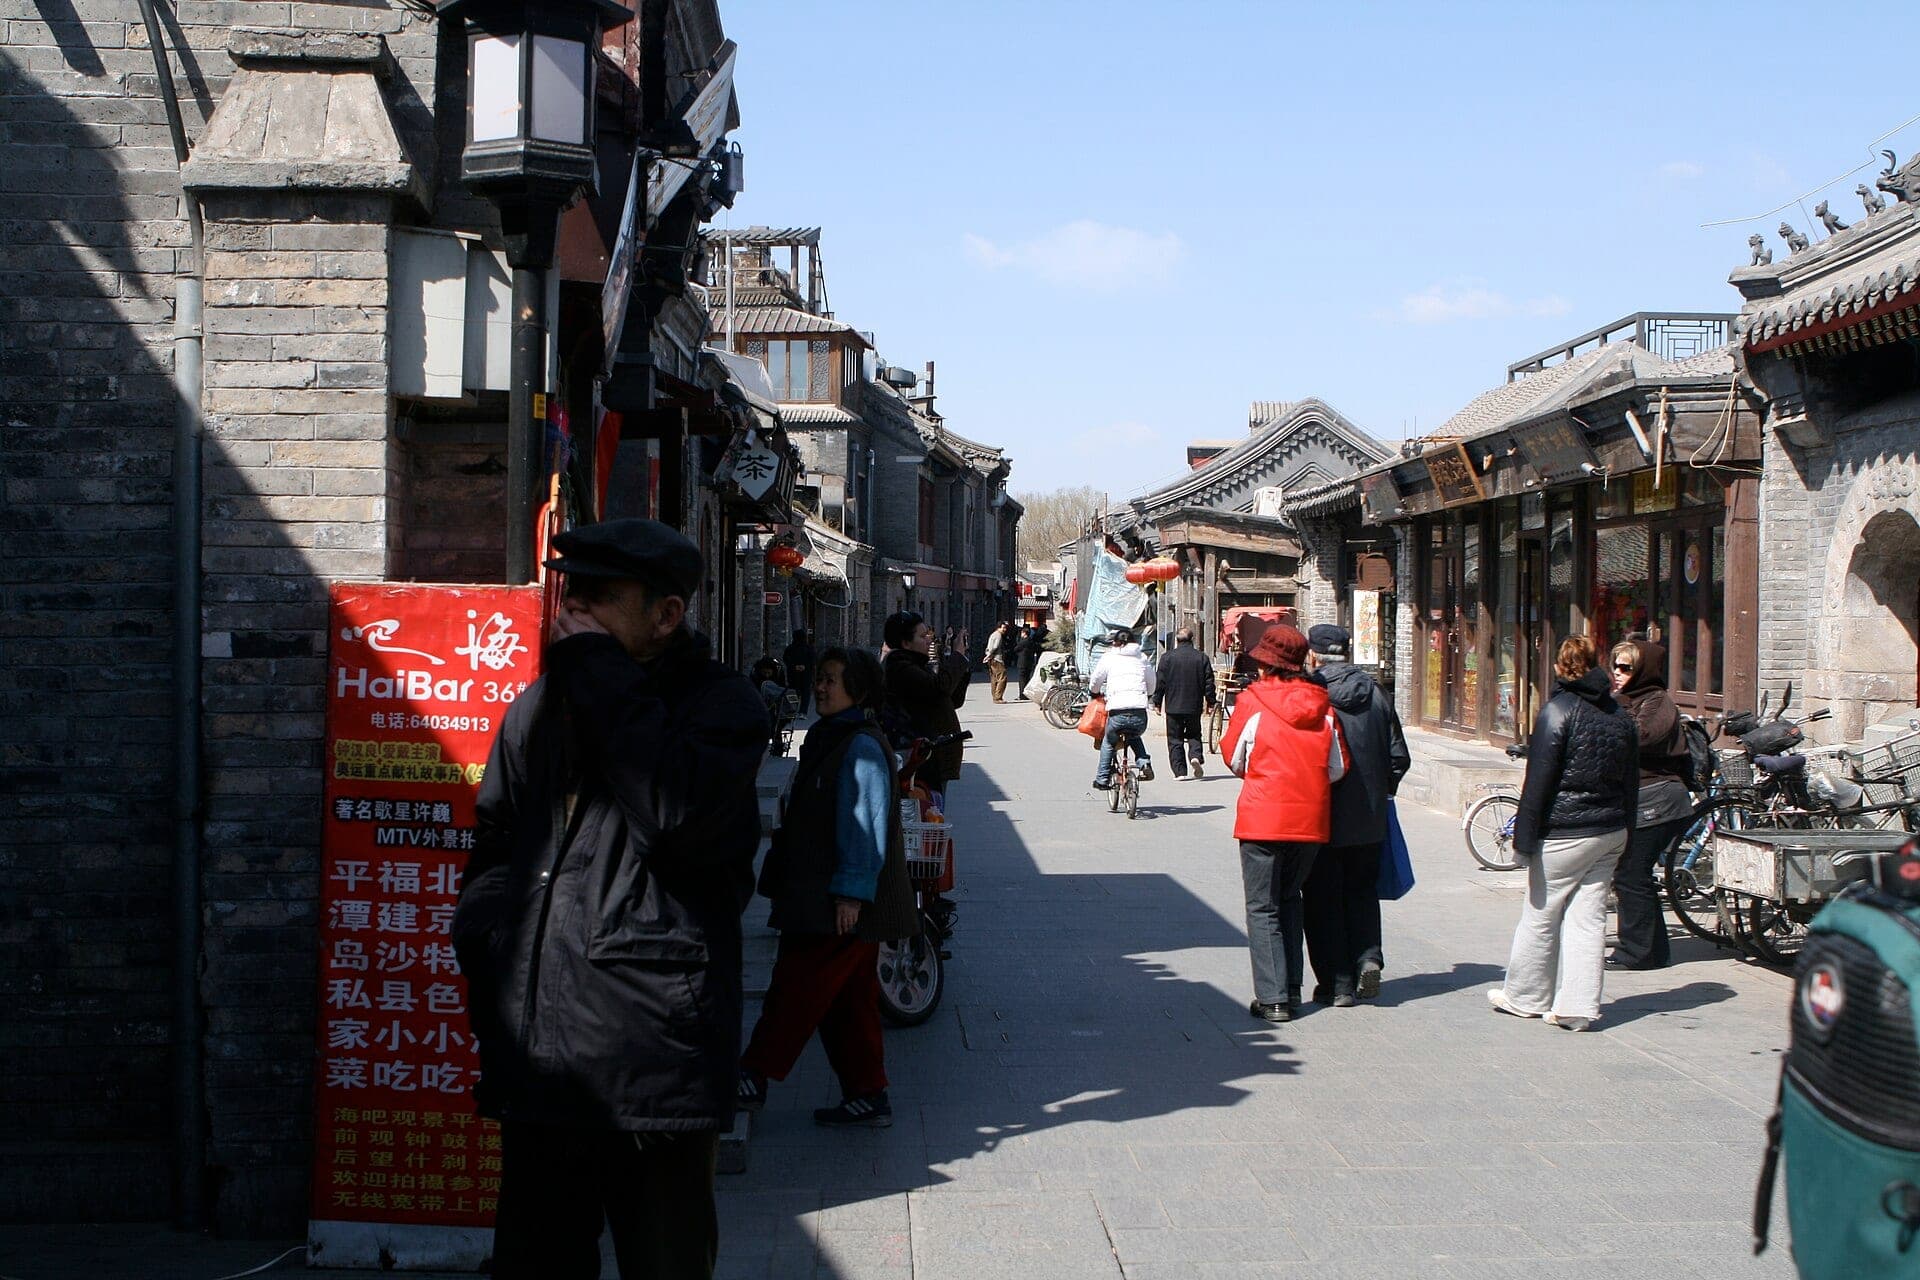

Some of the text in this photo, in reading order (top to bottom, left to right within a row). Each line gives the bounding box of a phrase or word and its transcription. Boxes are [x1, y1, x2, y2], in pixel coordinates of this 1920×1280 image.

[737, 455, 775, 480] 茶
[337, 668, 475, 702] HaiBar
[335, 799, 451, 823] 著名歌星许巍
